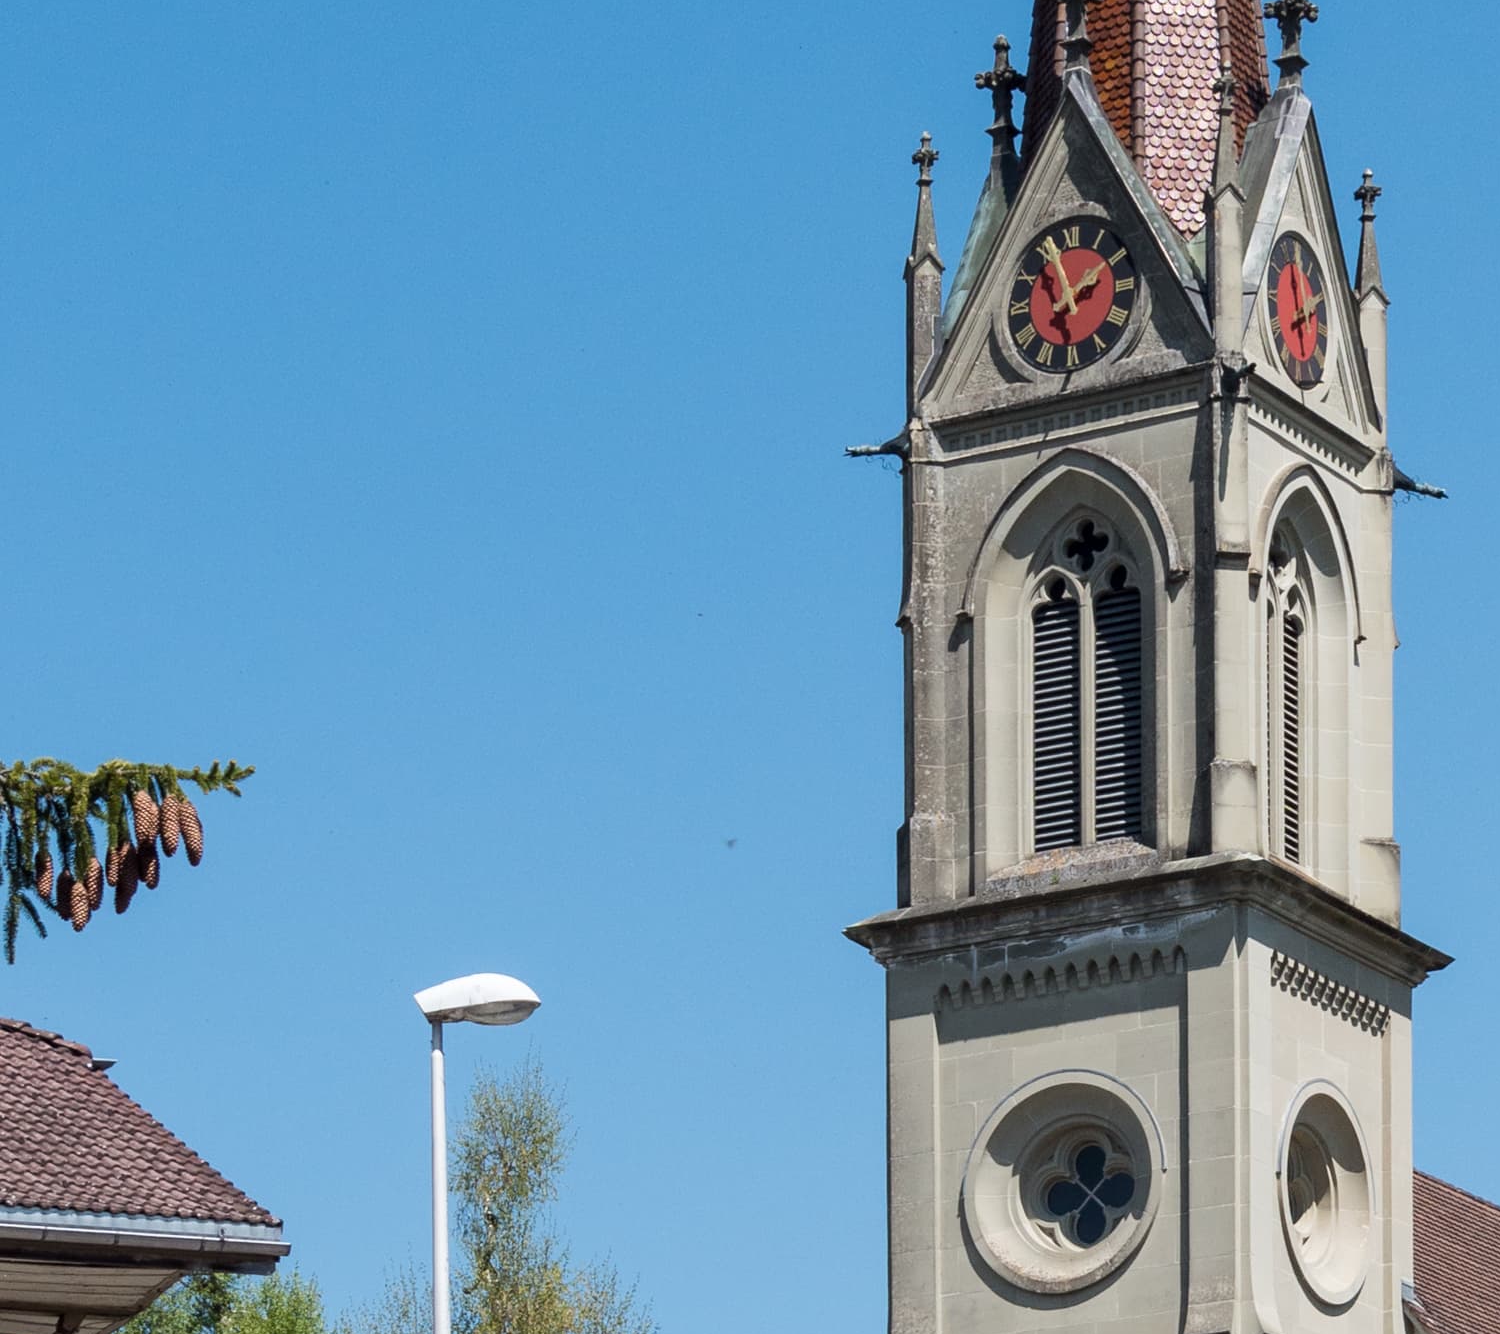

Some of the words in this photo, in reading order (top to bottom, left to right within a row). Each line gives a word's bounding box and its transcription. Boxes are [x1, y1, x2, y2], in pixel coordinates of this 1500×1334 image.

[1062, 226, 1080, 250] XII
[1092, 228, 1105, 249] I
[1109, 247, 1127, 266] II
[1017, 268, 1037, 286] X
[1115, 277, 1134, 292] III
[1009, 297, 1029, 317] IX
[1106, 304, 1130, 327] IIII
[1015, 322, 1037, 350] VIII
[1092, 331, 1107, 353] V
[1036, 340, 1054, 366] VII
[1067, 345, 1080, 366] VI
